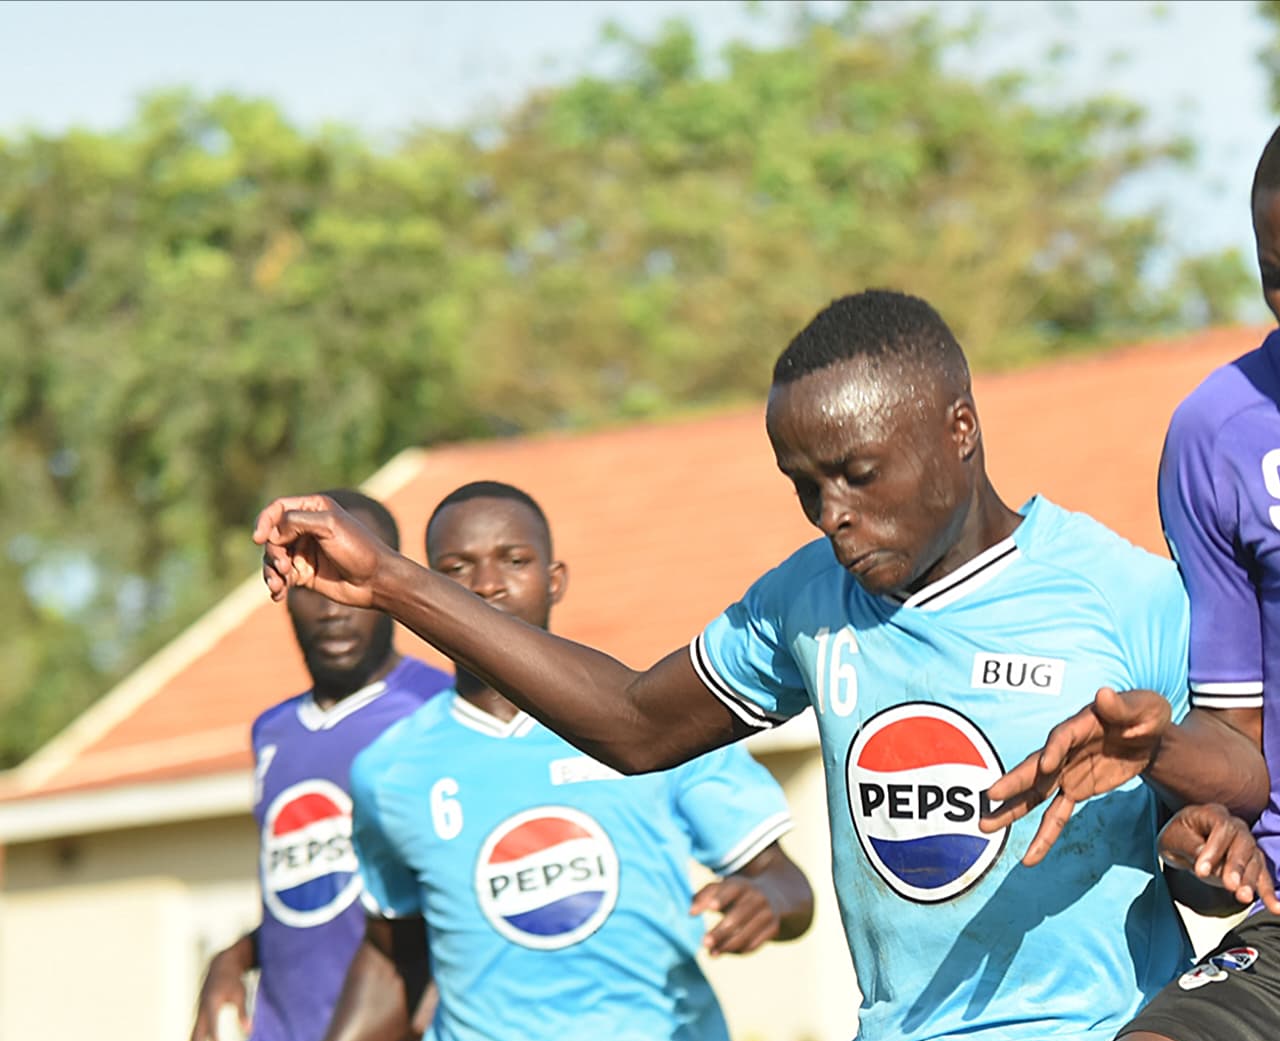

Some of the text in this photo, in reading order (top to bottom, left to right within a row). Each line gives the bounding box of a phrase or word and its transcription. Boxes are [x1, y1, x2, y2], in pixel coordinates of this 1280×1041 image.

[815, 626, 859, 717] 16
[982, 660, 1053, 688] BUG
[429, 777, 464, 840] 6
[858, 783, 990, 822] PEPSI
[269, 834, 354, 871] PEPS
[489, 856, 605, 899] PEPSI
